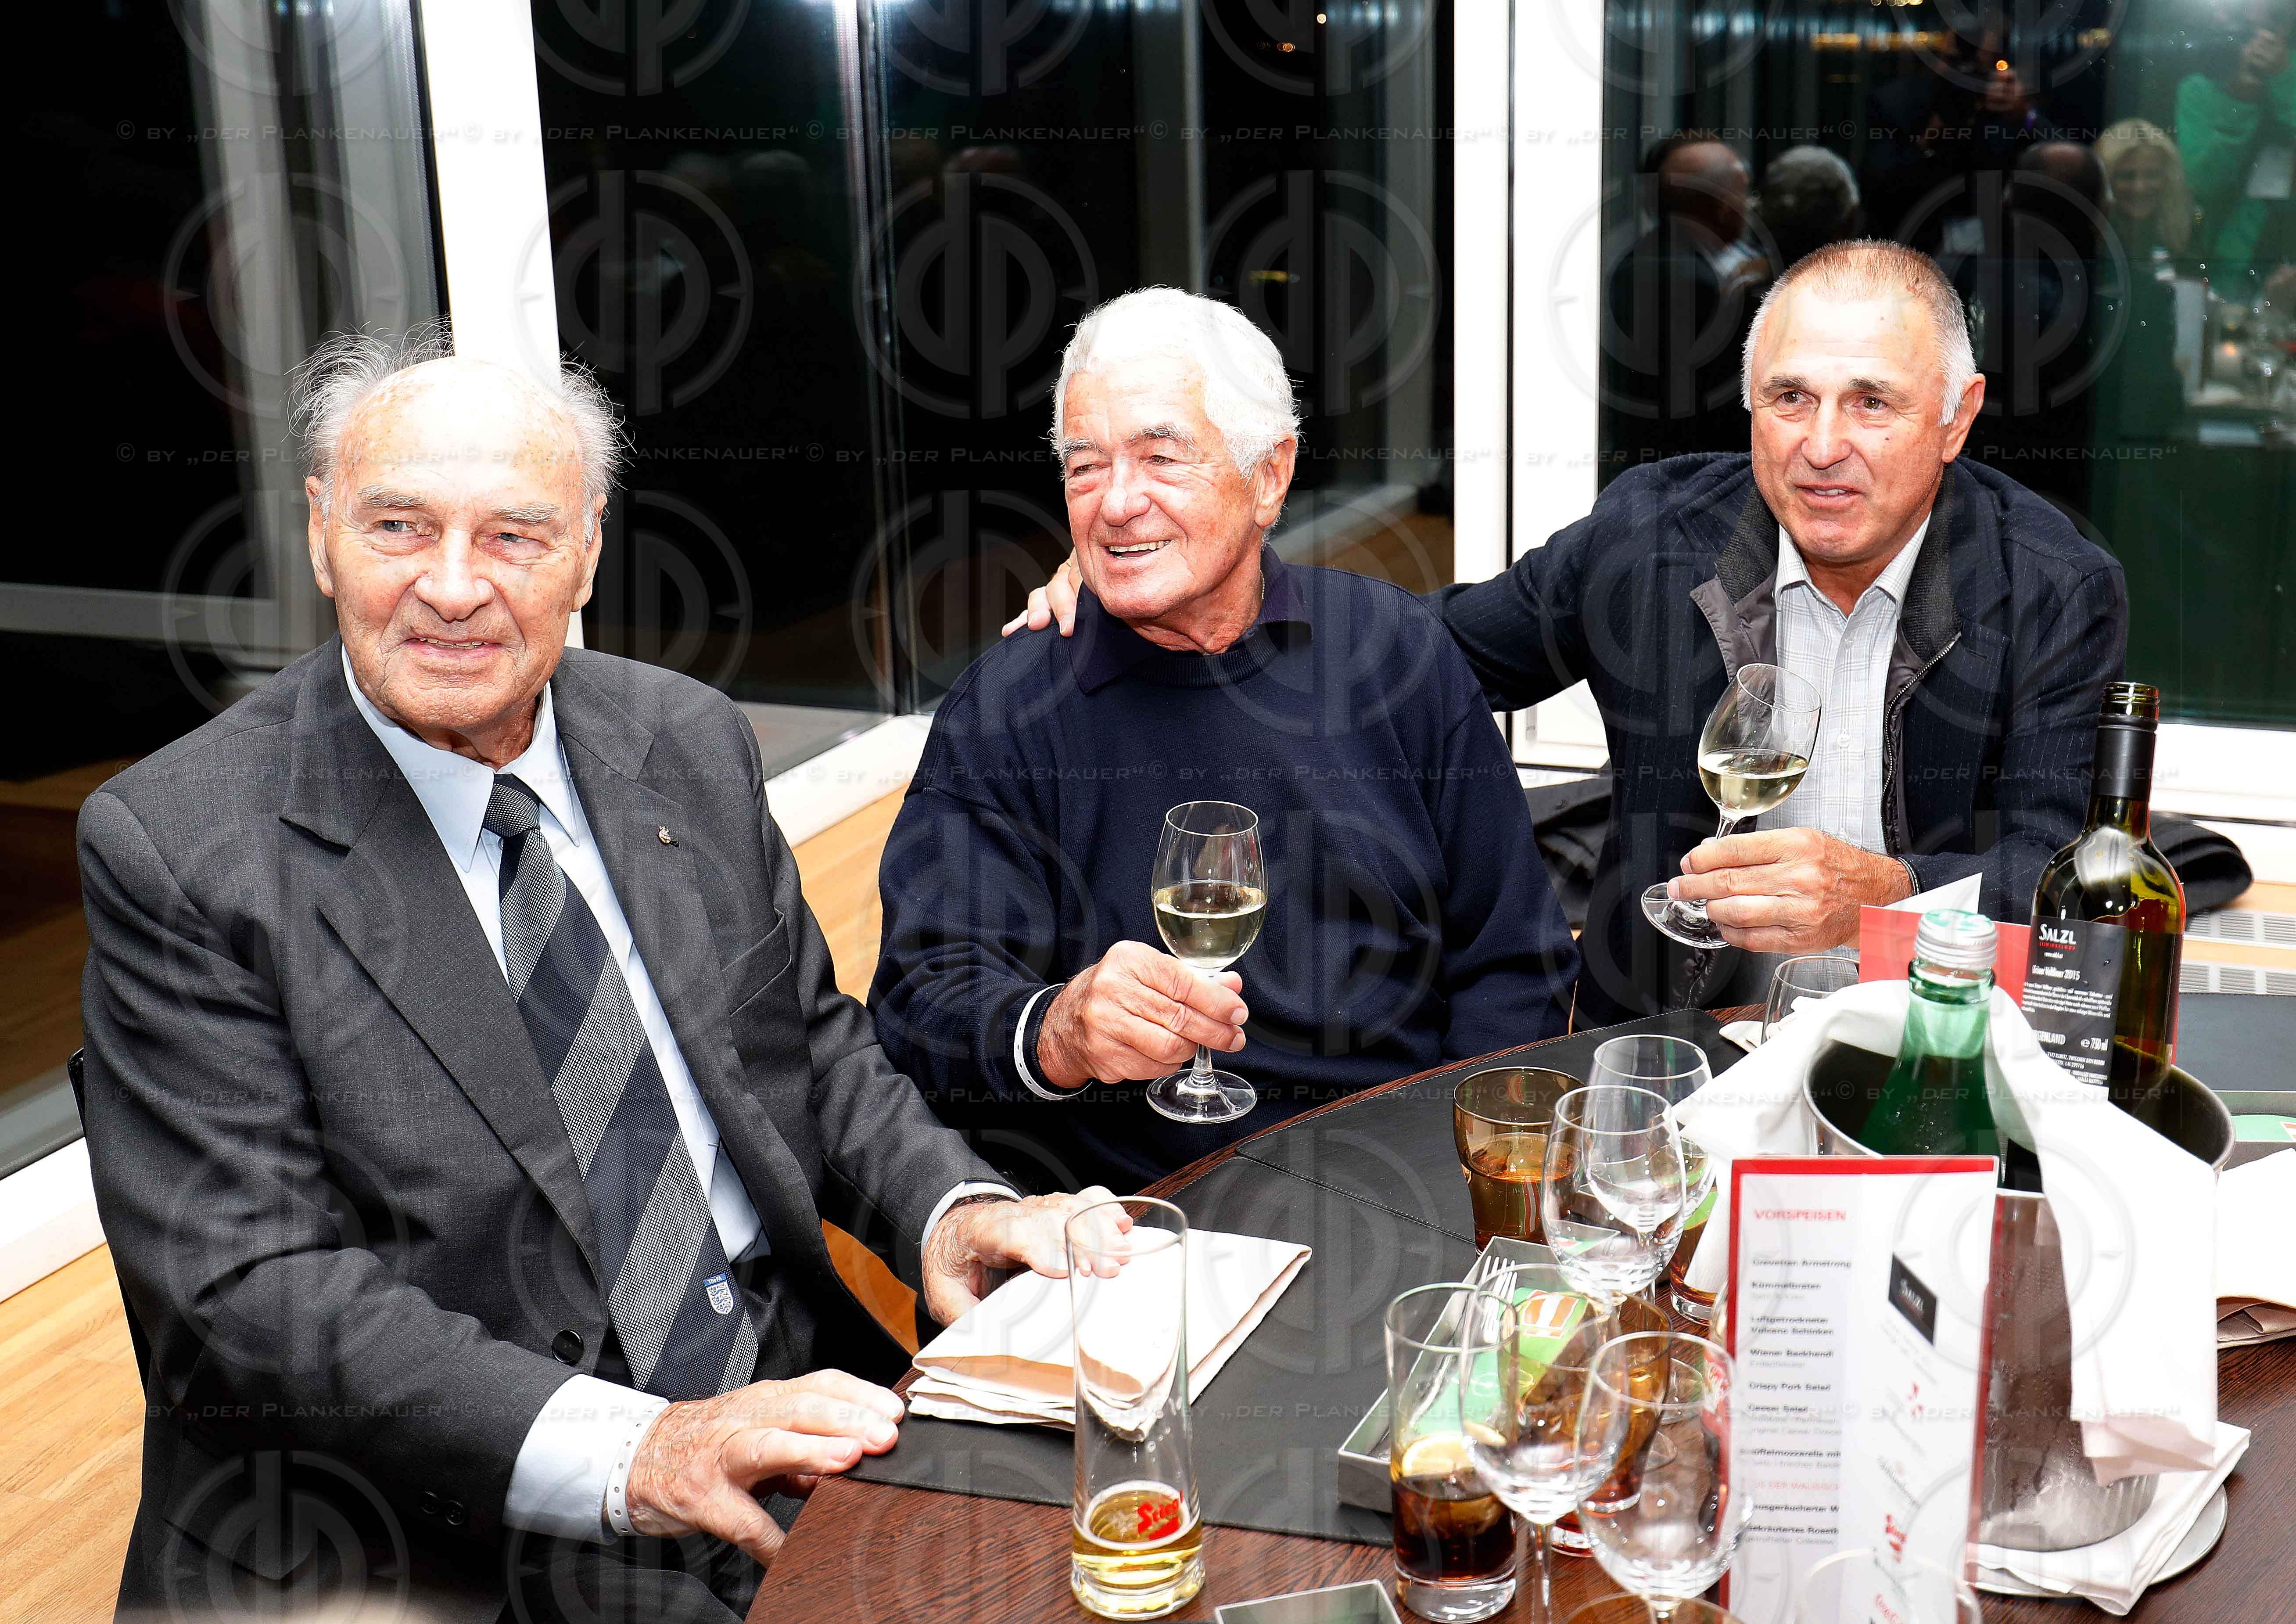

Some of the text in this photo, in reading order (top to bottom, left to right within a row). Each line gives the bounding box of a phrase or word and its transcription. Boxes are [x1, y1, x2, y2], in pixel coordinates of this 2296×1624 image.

[2039, 923, 2077, 945] SALZL
[1754, 1209, 1847, 1221] VORSPEISEN
[1749, 1381, 1778, 1391] Crispy
[1750, 1503, 1827, 1513] ausgeräucherter
